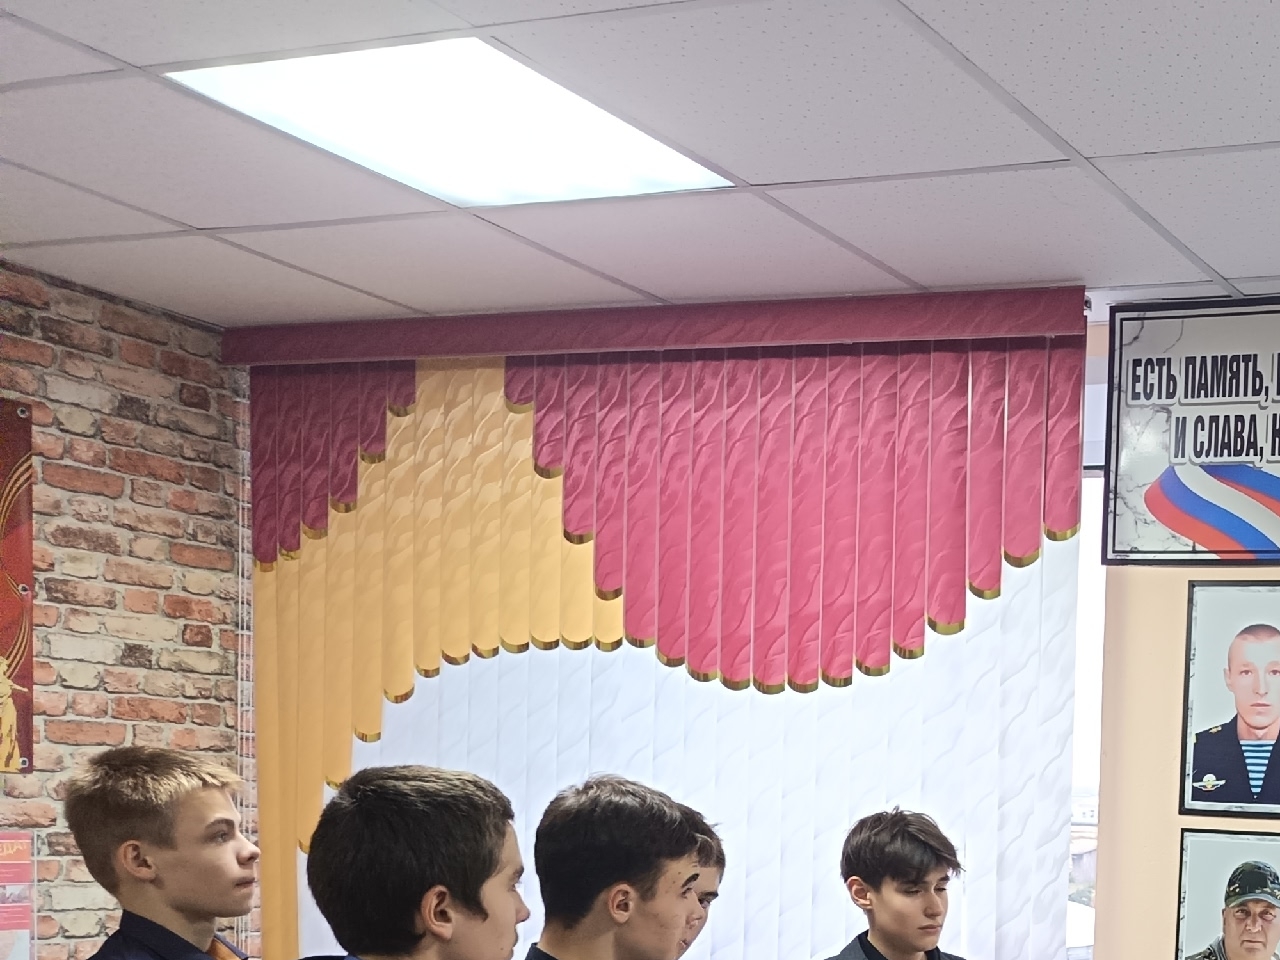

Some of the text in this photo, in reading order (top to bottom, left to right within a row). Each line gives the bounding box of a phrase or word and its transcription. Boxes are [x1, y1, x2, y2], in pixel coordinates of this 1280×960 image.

[1131, 357, 1177, 400] ЕСТЬ
[1183, 351, 1269, 402] ПАМЯТЬ,
[1174, 416, 1187, 458] И
[1193, 413, 1264, 461] СЛАВА,
